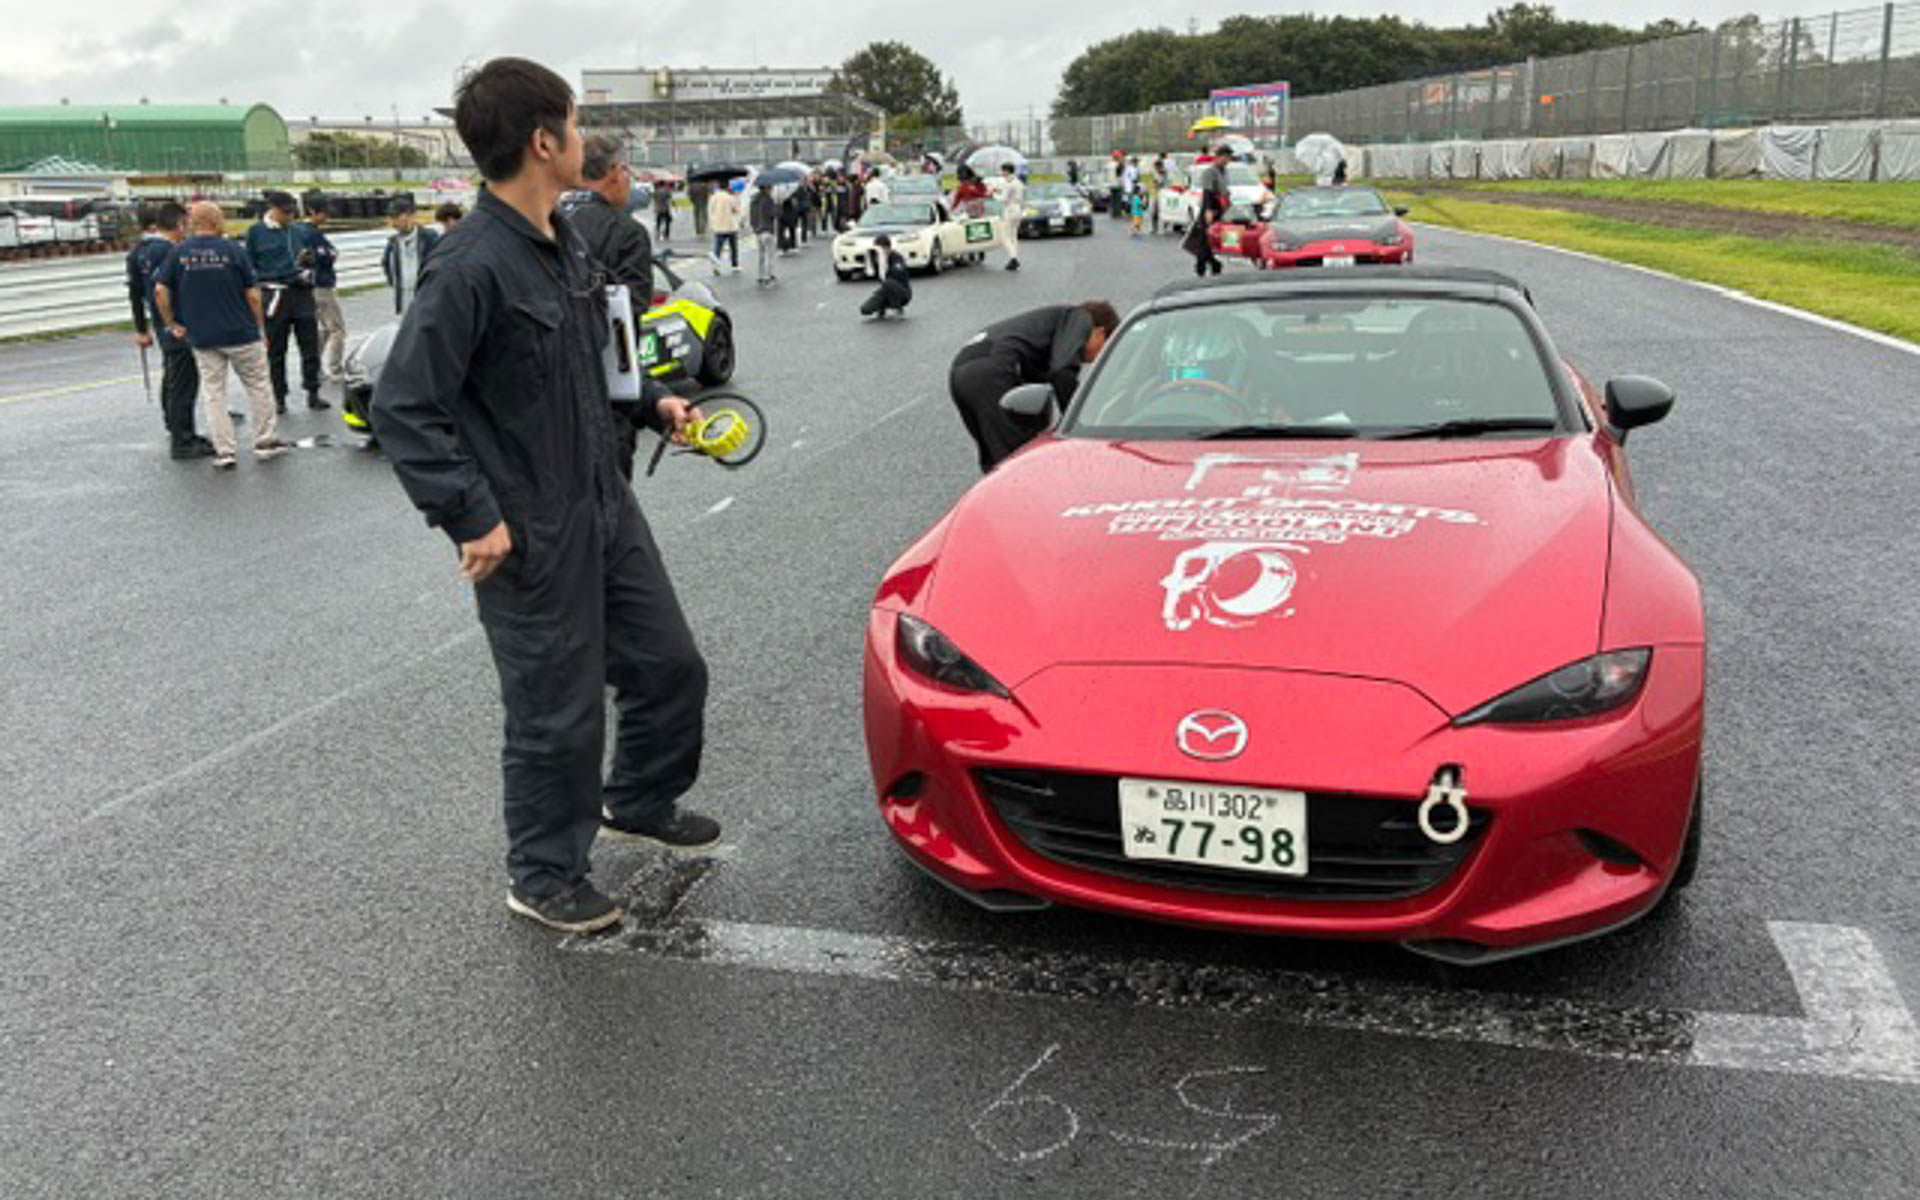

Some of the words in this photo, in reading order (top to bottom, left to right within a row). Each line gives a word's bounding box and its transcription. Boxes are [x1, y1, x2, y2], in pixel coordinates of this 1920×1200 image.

[1061, 497, 1243, 517] KNIGHT
[1133, 825, 1156, 845] ぬ
[1161, 818, 1296, 868] 77-98
